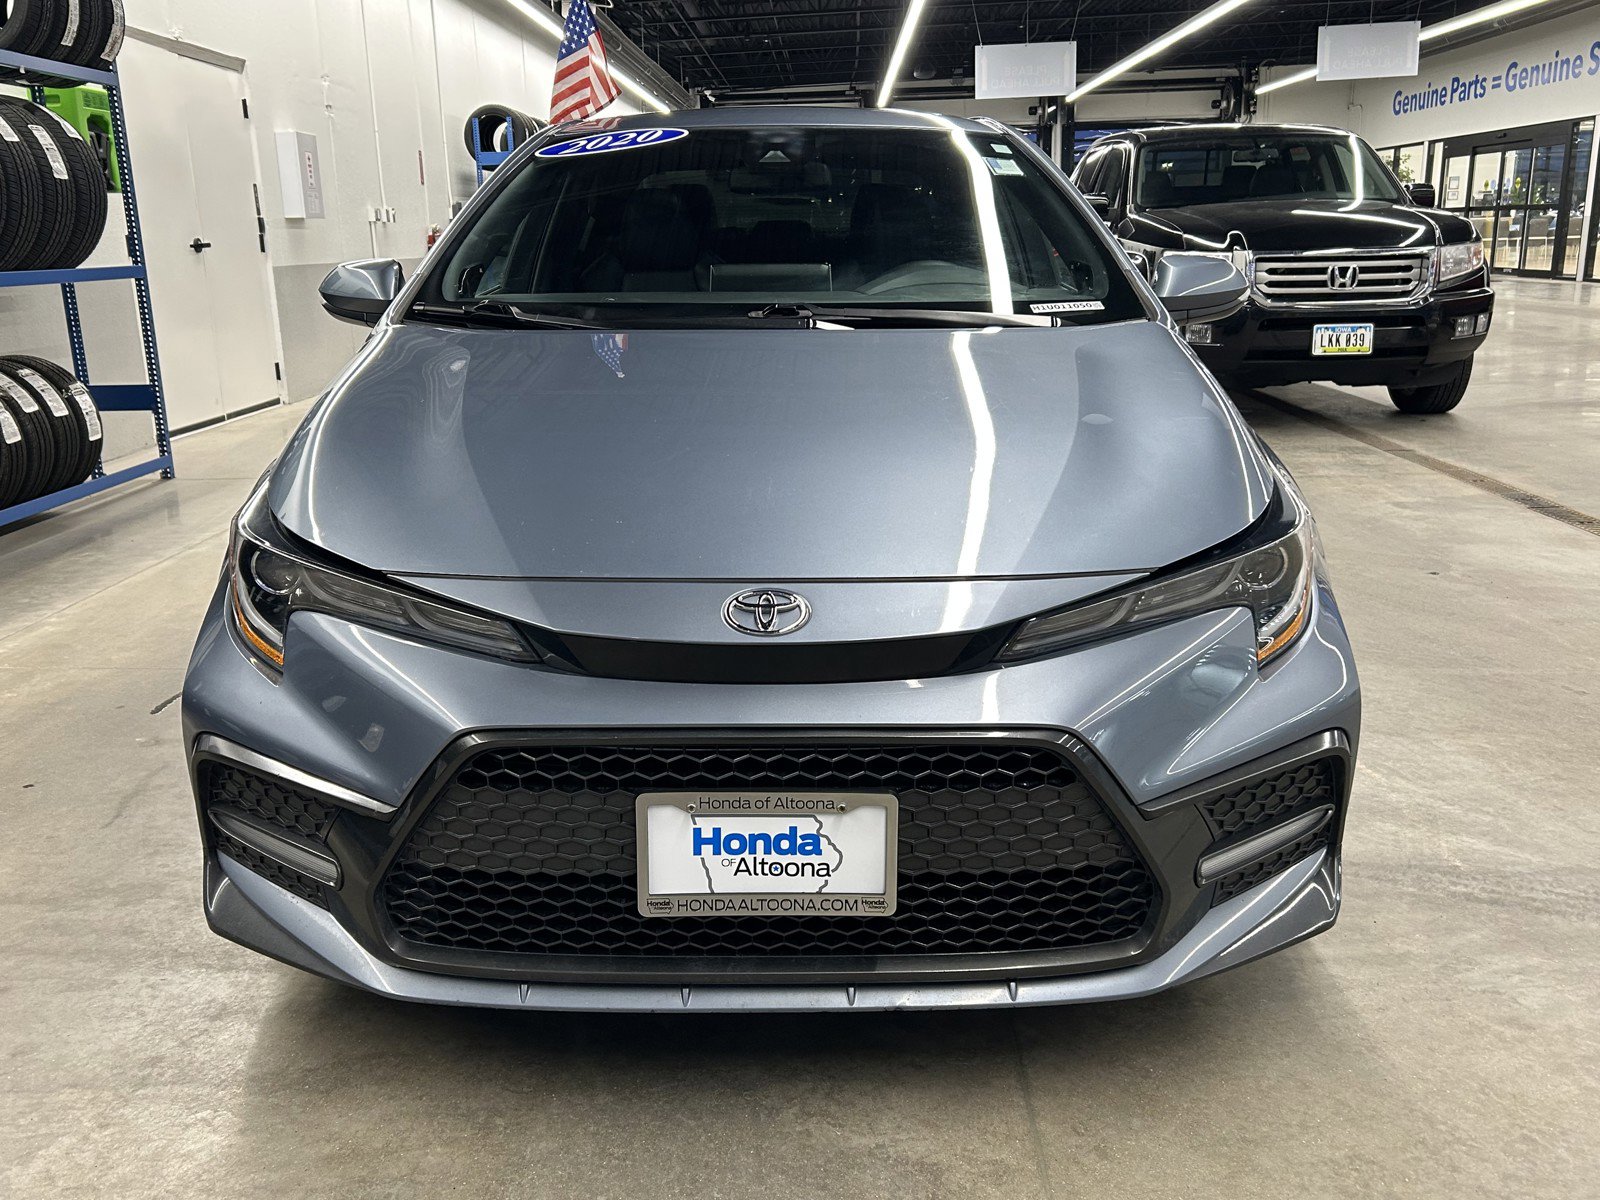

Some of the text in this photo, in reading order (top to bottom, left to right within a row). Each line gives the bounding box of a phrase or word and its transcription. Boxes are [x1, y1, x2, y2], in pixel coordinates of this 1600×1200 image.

[1392, 82, 1447, 116] Genuine
[1449, 74, 1487, 104] Parts
[1491, 75, 1502, 90] =
[1505, 50, 1584, 92] Genuine
[557, 129, 664, 155] 2020
[1321, 333, 1365, 347] LKK 039
[699, 797, 835, 810] Honda of Altoona
[692, 826, 823, 857] Honda
[721, 857, 832, 878] OF Altoona
[676, 898, 859, 912] HONDAALTOONA.COM
